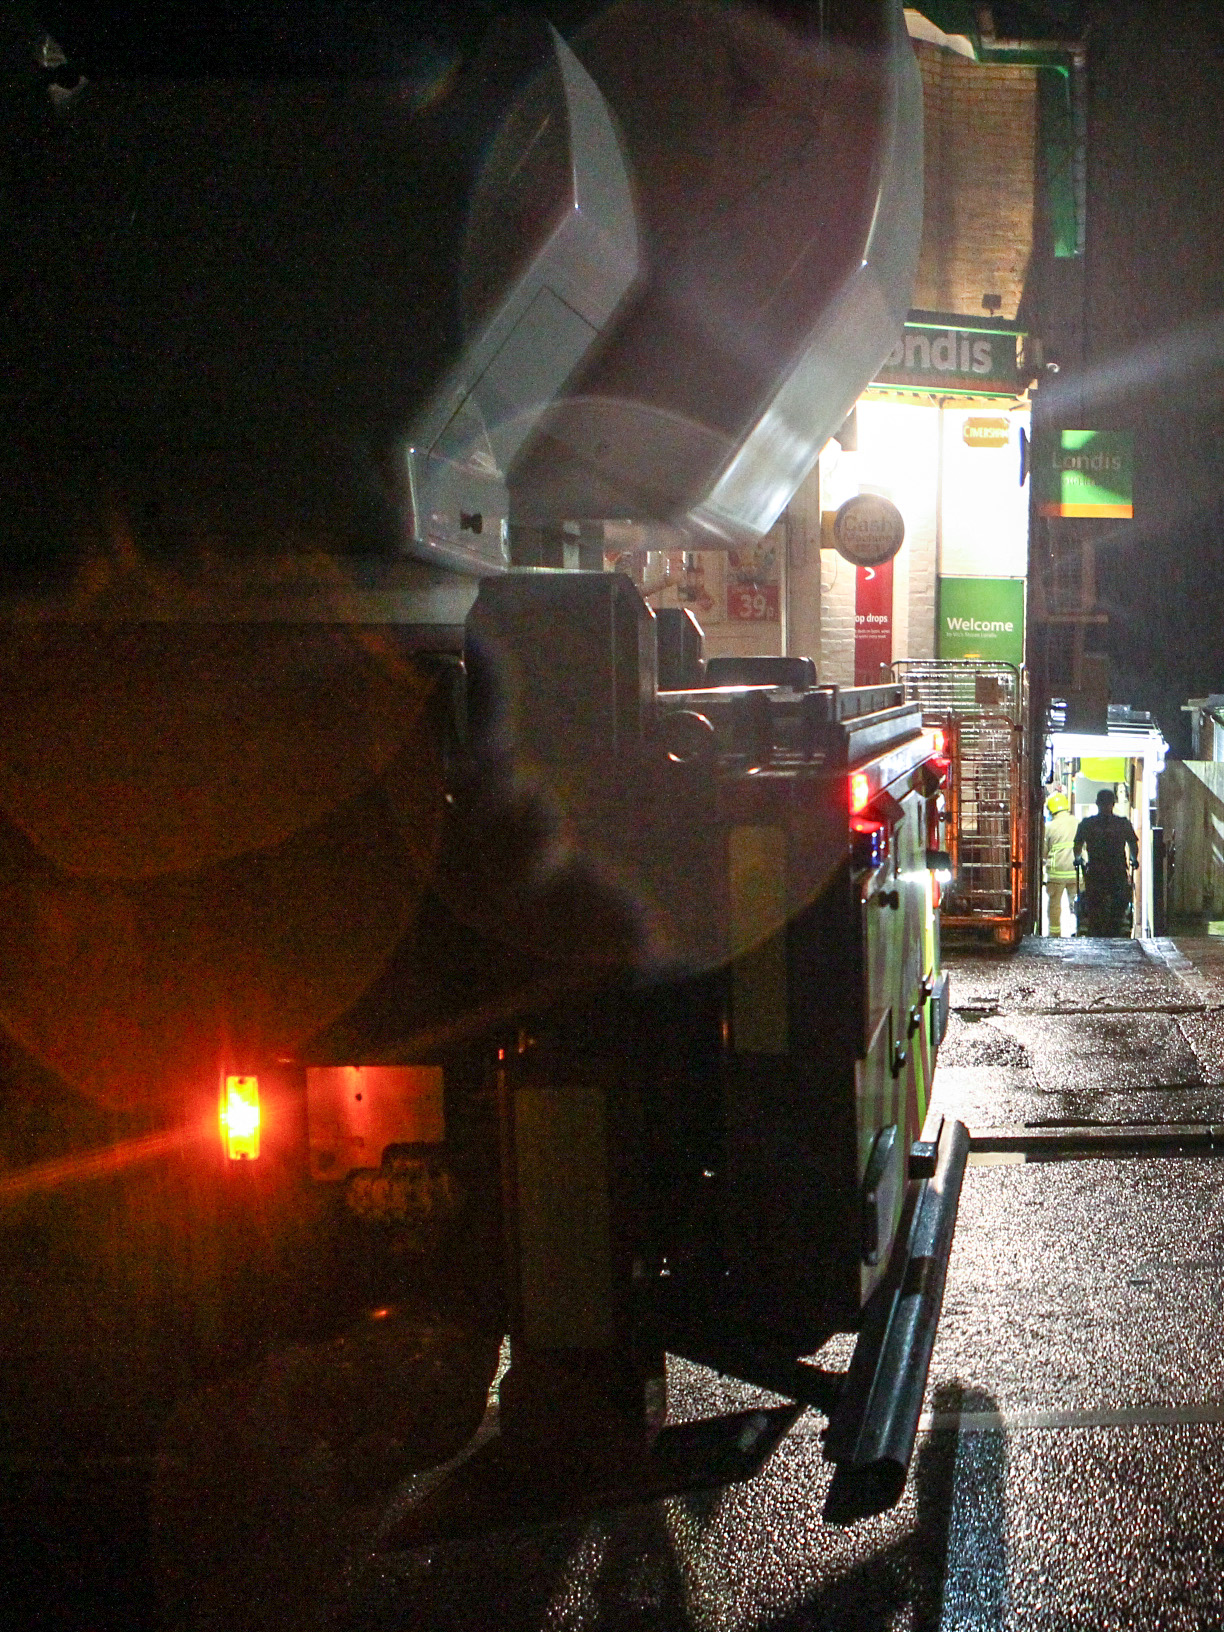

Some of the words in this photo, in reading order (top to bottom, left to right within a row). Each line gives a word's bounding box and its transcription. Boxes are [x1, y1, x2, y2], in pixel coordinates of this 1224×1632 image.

[1052, 451, 1121, 471] Londis
[866, 612, 888, 625] drops
[946, 616, 1014, 632] Welcome
